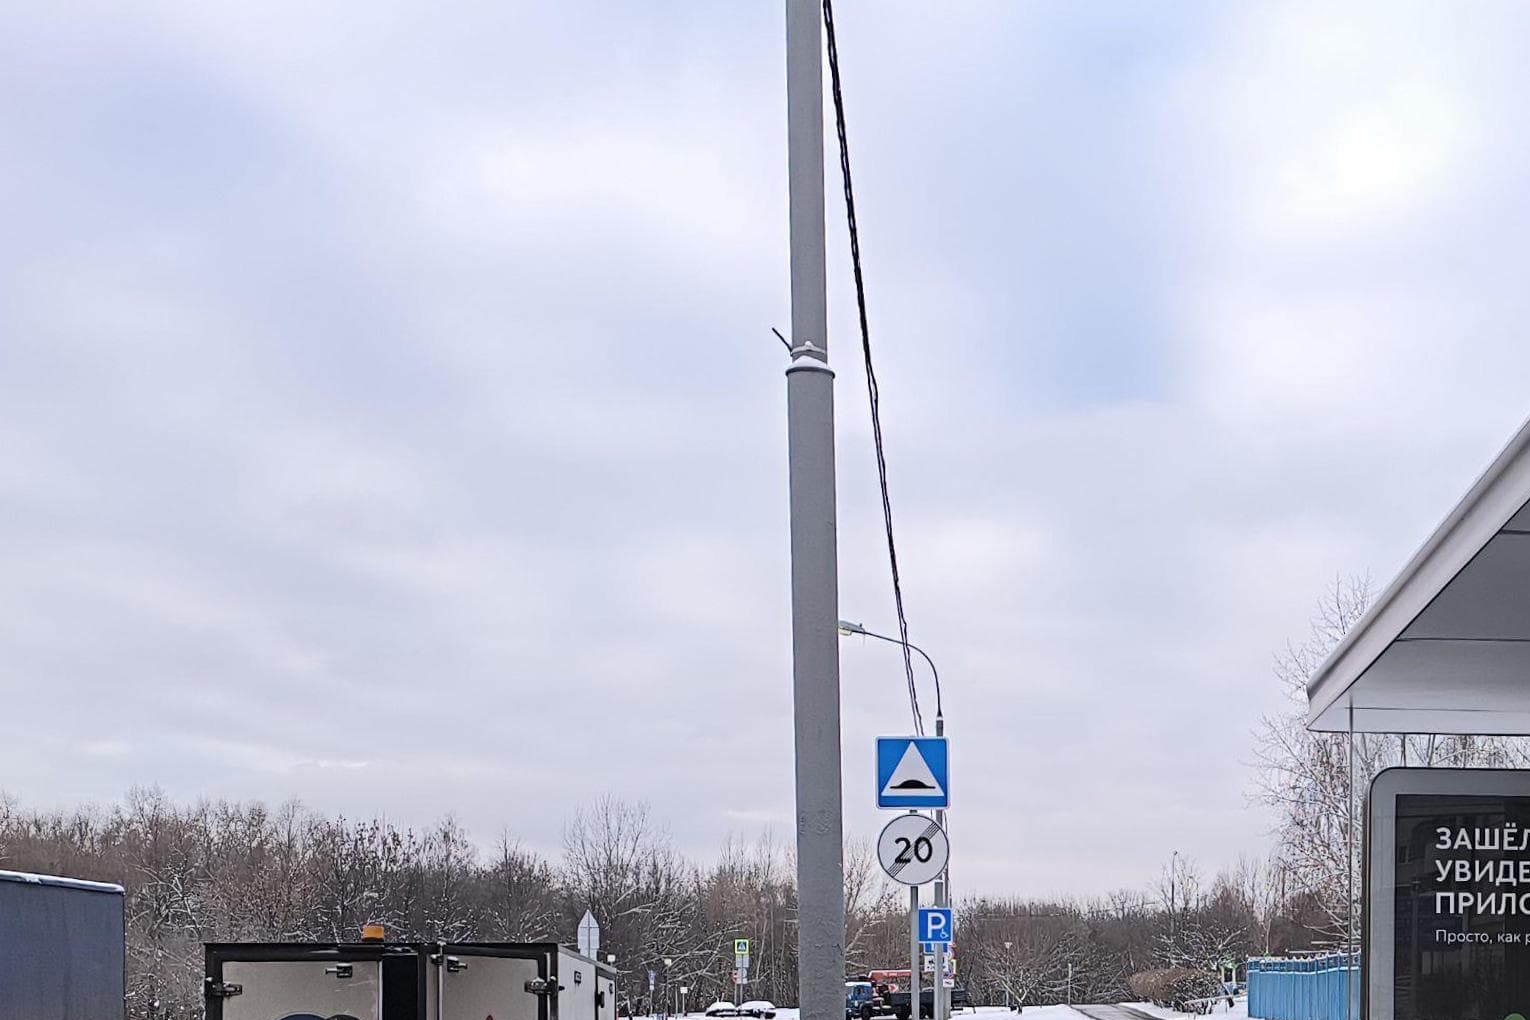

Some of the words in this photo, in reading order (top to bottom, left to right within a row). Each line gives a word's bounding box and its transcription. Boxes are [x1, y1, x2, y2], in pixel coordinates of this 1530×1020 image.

[894, 836, 933, 863] 20
[928, 912, 946, 938] P
[1435, 929, 1493, 945] Просто,
[1497, 932, 1521, 943] как
